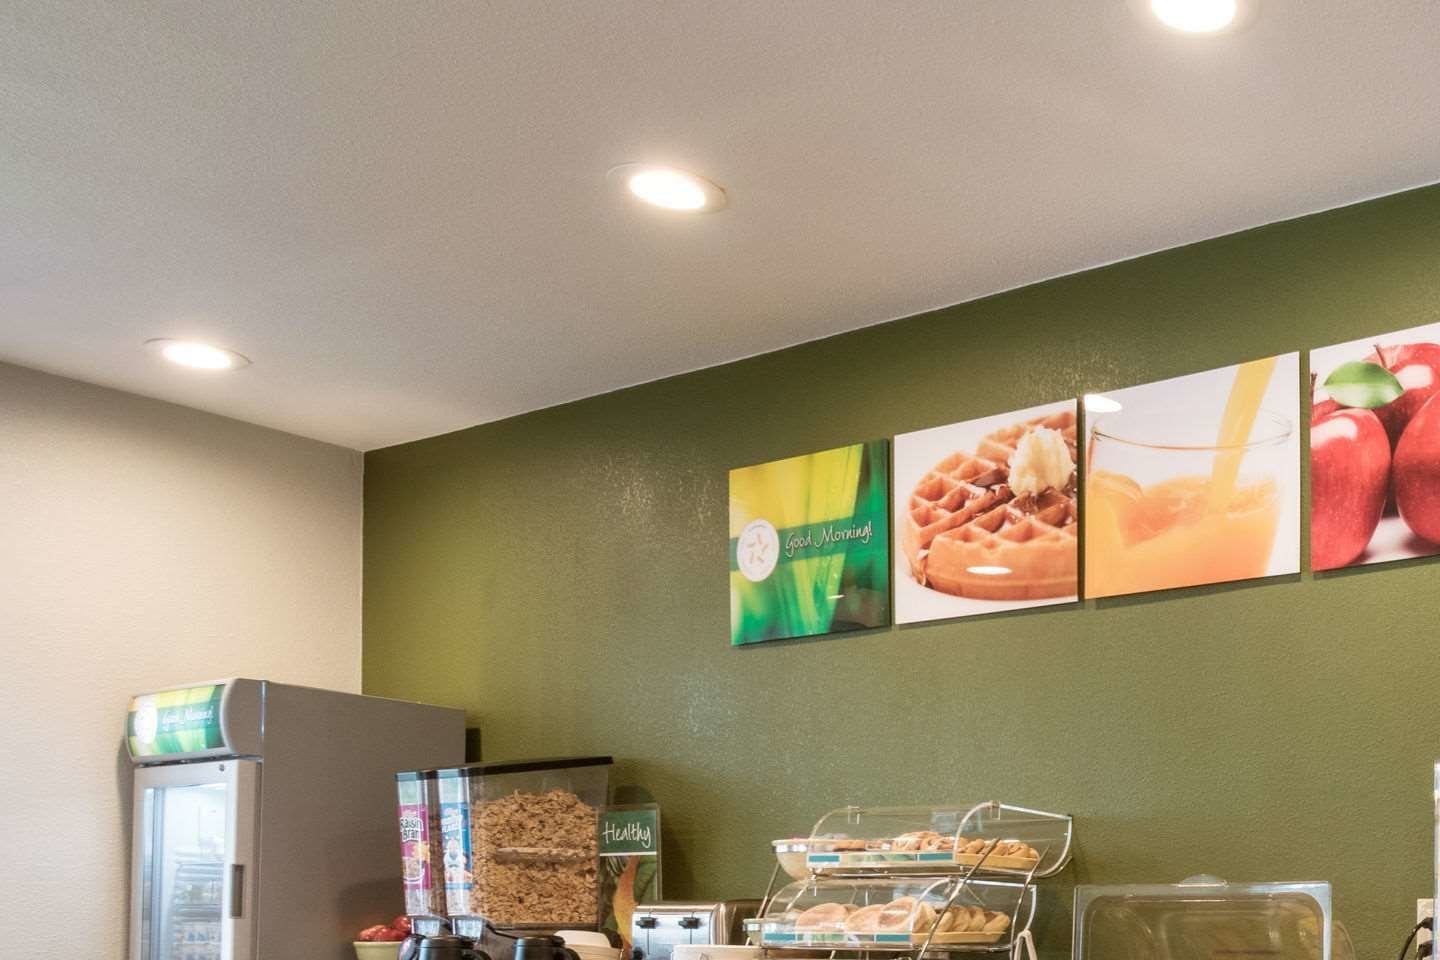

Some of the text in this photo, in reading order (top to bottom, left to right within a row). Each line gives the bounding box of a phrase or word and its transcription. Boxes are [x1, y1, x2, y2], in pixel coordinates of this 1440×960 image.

[785, 520, 873, 558] Good Morning!
[602, 821, 651, 849] Healthy
